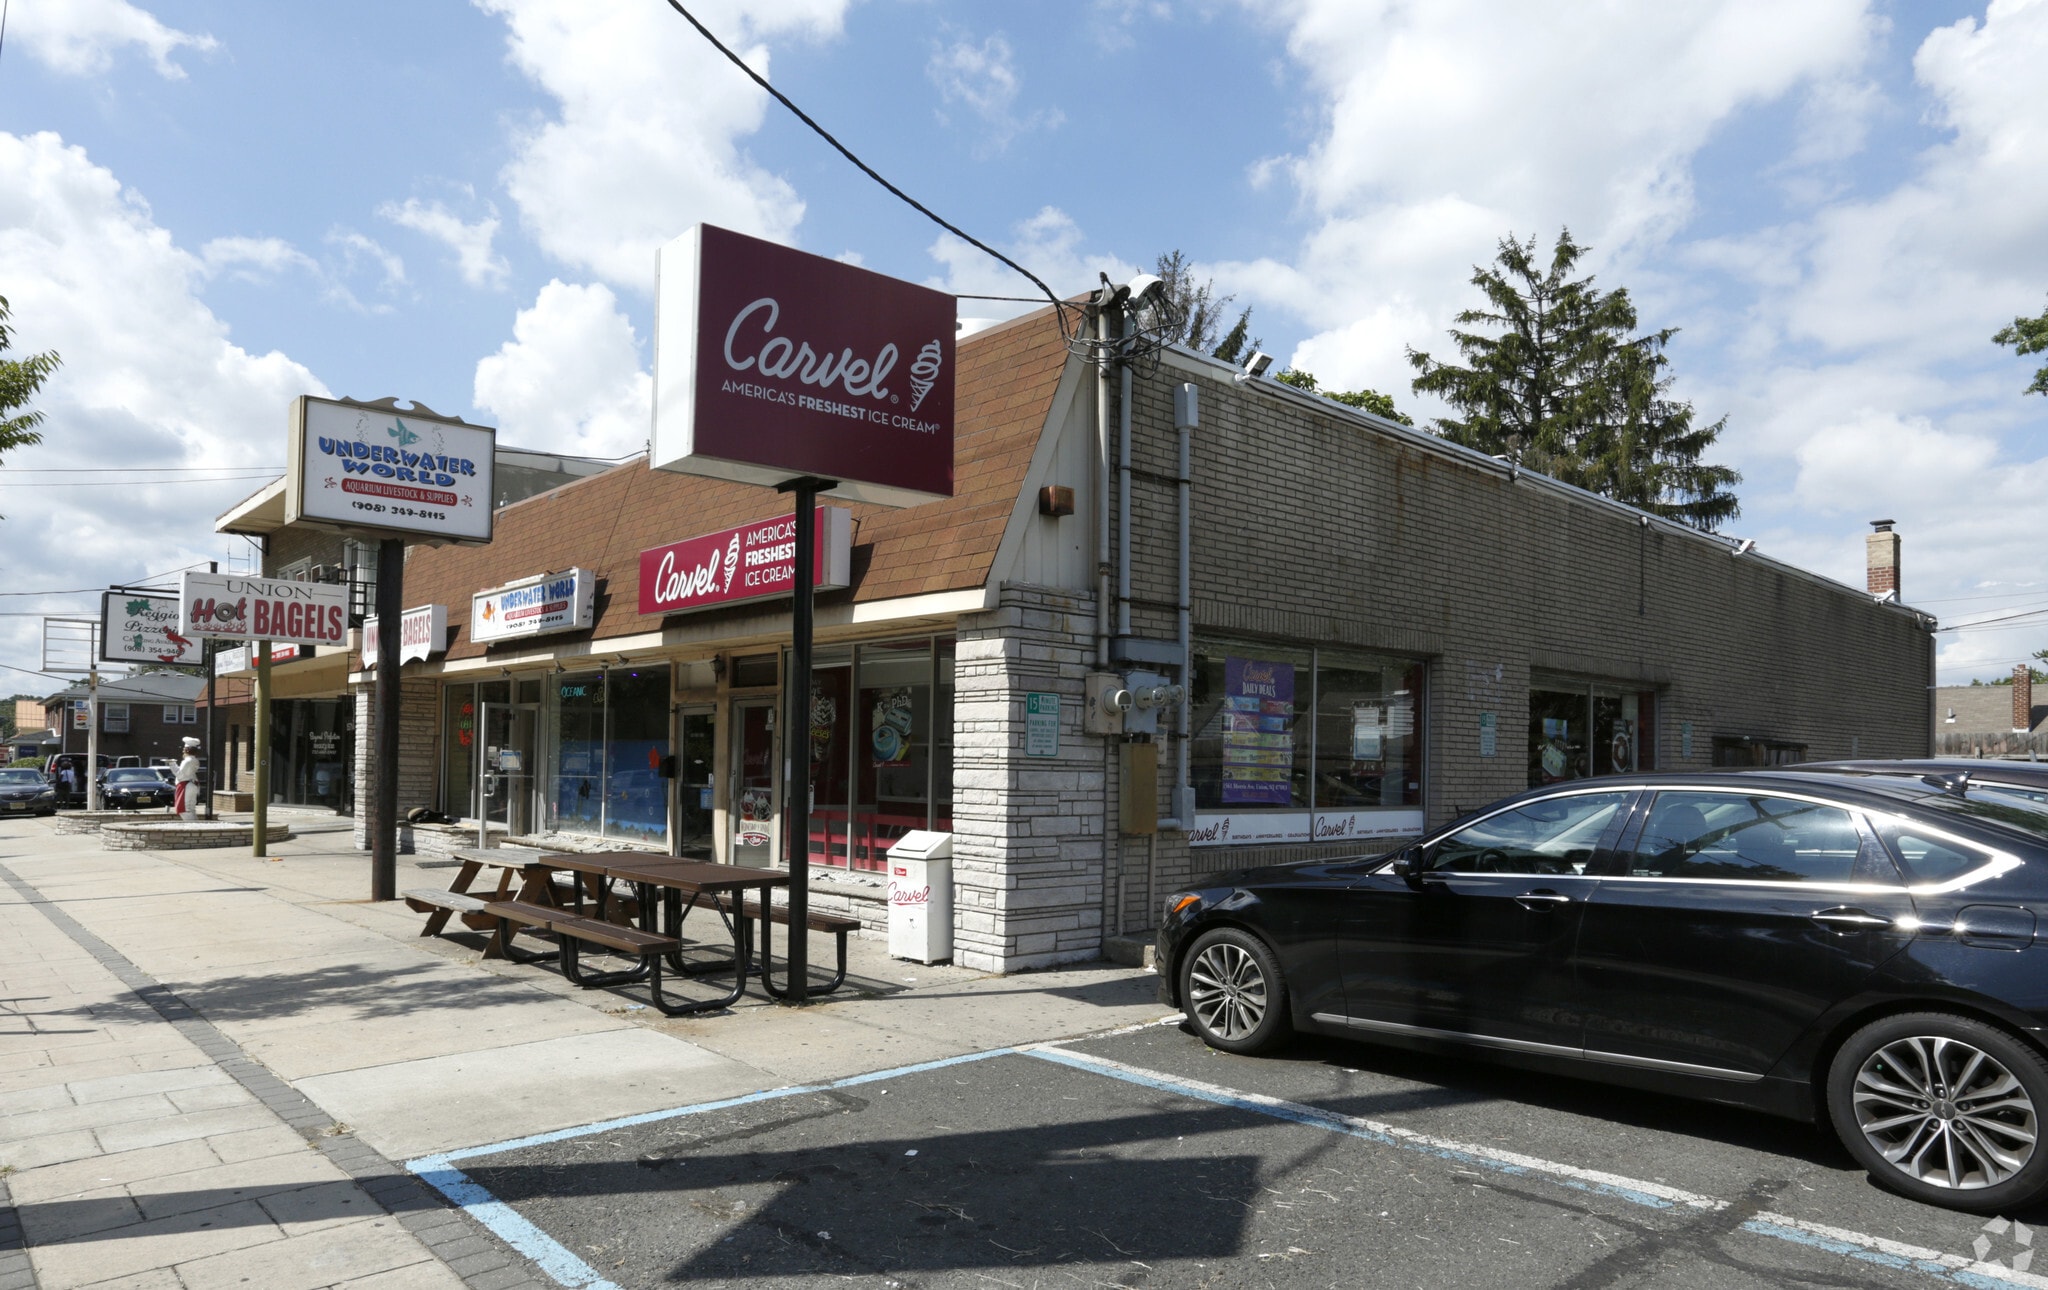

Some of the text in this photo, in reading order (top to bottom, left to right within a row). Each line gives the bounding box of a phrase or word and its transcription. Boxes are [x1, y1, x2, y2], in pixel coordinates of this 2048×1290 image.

[724, 297, 899, 400] Carvel
[721, 379, 936, 435] AMERICA'S FRESHEST ICE CREAM
[318, 436, 477, 477] UNDERWATER
[342, 458, 456, 487] WORLD
[345, 480, 454, 504] AQUARIUM LIVESTOCK & SUPPLIES
[352, 500, 386, 514] (908)
[654, 549, 720, 604] Carvel
[745, 565, 796, 587] ICE CREAM
[224, 579, 314, 600] UNION
[500, 578, 575, 611] UNDERWATER WORLD
[190, 597, 343, 641] Hot BAGELS
[403, 614, 431, 647] BAGELS
[561, 686, 587, 698] OCEANIC
[1242, 681, 1276, 698] DAILY DEALS
[1029, 697, 1038, 711] 15
[1189, 822, 1219, 842] arvel
[1315, 816, 1347, 837] Carvel
[888, 881, 931, 903] Carvel
